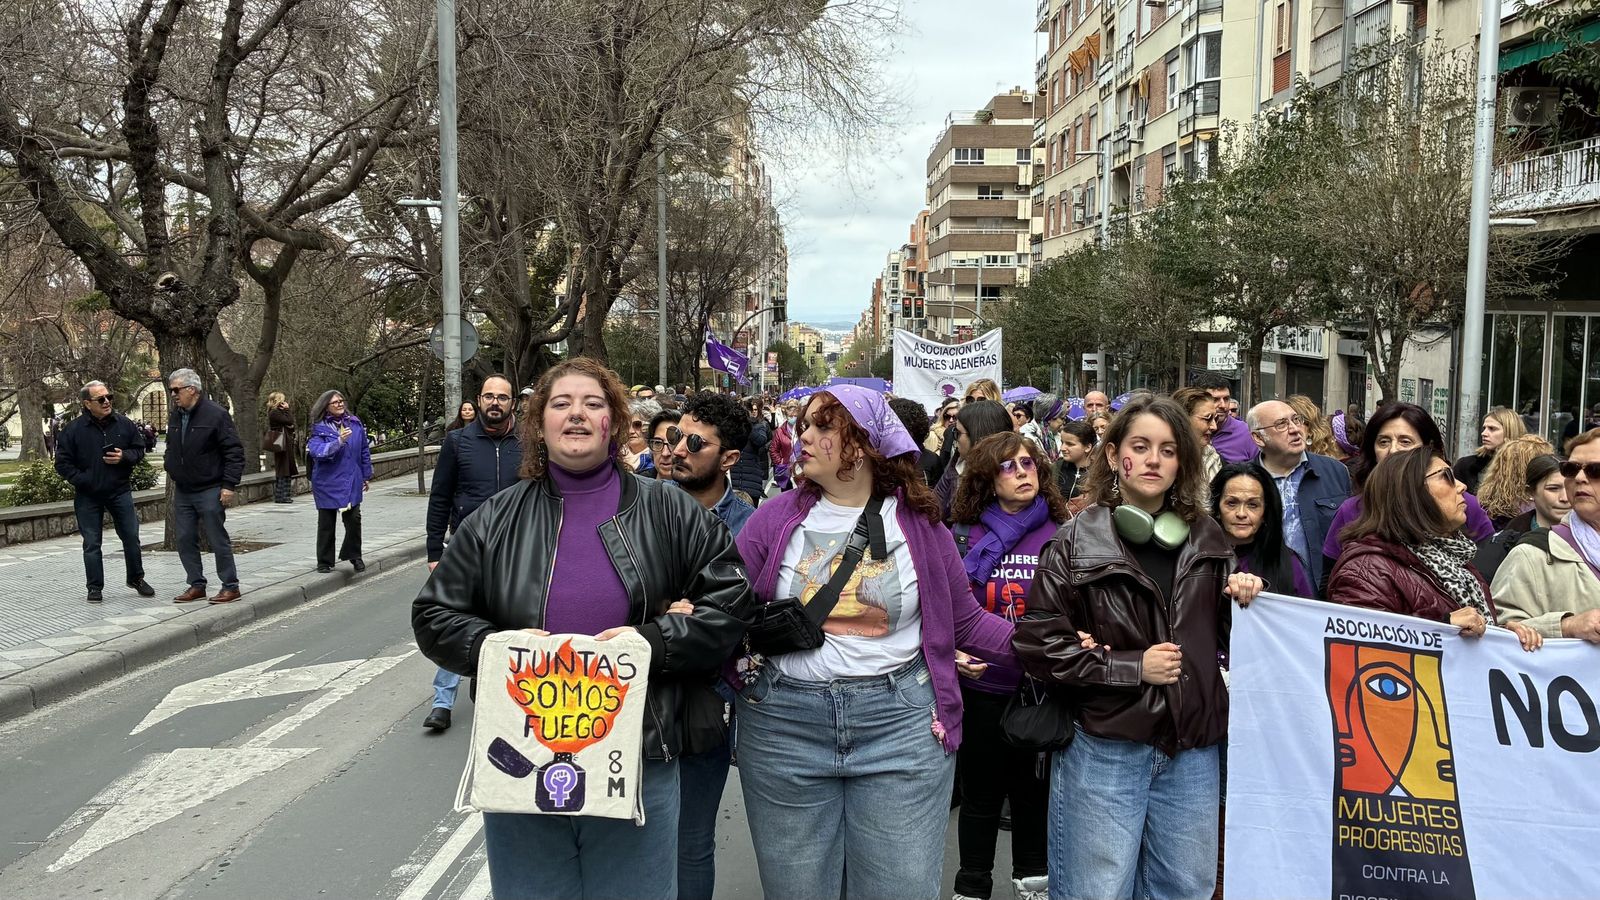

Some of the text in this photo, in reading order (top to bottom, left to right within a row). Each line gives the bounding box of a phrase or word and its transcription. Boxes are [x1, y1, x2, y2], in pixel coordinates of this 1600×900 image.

[903, 354, 997, 370] MUJERES JAENERAS
[974, 340, 987, 352] DE
[1000, 554, 1039, 565] UJERE
[1324, 616, 1443, 649] ASOCIACIÓN DE
[507, 646, 637, 680] JUNTAS
[514, 680, 621, 713] SOMOS
[1488, 667, 1600, 754] NO
[523, 713, 608, 740] FUEGO
[1337, 796, 1459, 830] MUJERES
[1338, 825, 1463, 857] PROGRESISTAS
[1362, 864, 1450, 885] CONTRA LA
